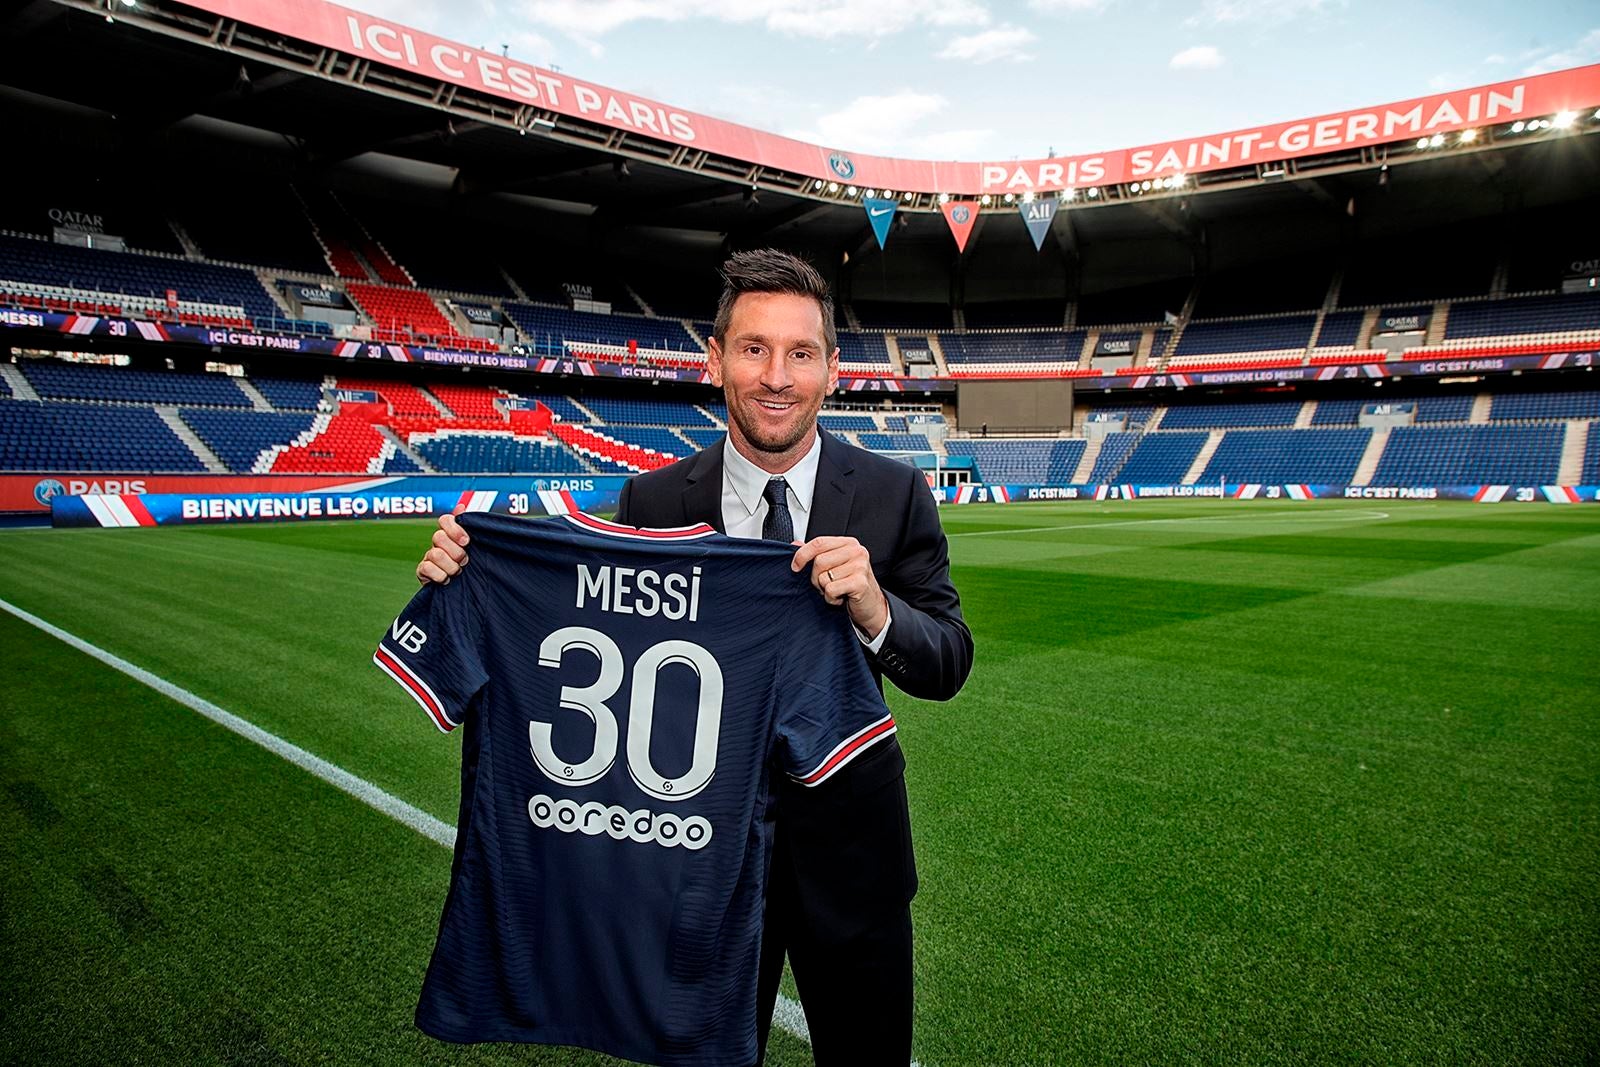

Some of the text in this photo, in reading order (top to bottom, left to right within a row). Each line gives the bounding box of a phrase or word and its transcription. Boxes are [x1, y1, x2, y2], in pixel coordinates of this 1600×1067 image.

[347, 16, 696, 142] ICI C'EST PARIS
[983, 85, 1525, 189] PARIS SAINT-GERMAIN
[48, 208, 103, 227] QATAR
[300, 287, 331, 299] QATAR
[0, 311, 44, 327] MESSI
[467, 308, 492, 319] QATAR
[108, 320, 127, 336] 30
[1385, 316, 1419, 328] QATAR
[209, 331, 301, 350] ICI C'EST PARIS
[1103, 341, 1130, 350] QATAR
[367, 344, 382, 359] 30
[423, 351, 528, 369] BIENVENUE LEO MESSI
[1420, 359, 1503, 373] ICI C'EST PARIS
[1575, 353, 1592, 366] 30
[562, 361, 574, 374] 30
[621, 367, 633, 377] ICI
[656, 369, 678, 380] PARIS
[1344, 366, 1358, 378] 30
[1154, 375, 1167, 387] 30
[1254, 371, 1273, 382] LEO
[870, 380, 880, 391] 30
[69, 480, 147, 495] PARIS
[550, 479, 594, 491] PARIS
[1174, 486, 1193, 496] LEO
[1194, 486, 1221, 497] MESS
[977, 488, 988, 502] 30
[1028, 488, 1039, 499] ICI
[1266, 486, 1281, 498] 30
[1344, 487, 1437, 498] ICI C'EST PARIS
[1515, 487, 1534, 501] 30
[182, 495, 433, 518] BIENVENUE LEO MESSI
[508, 493, 529, 514] 30
[528, 626, 724, 801] 30
[531, 798, 710, 846] ooredoo
